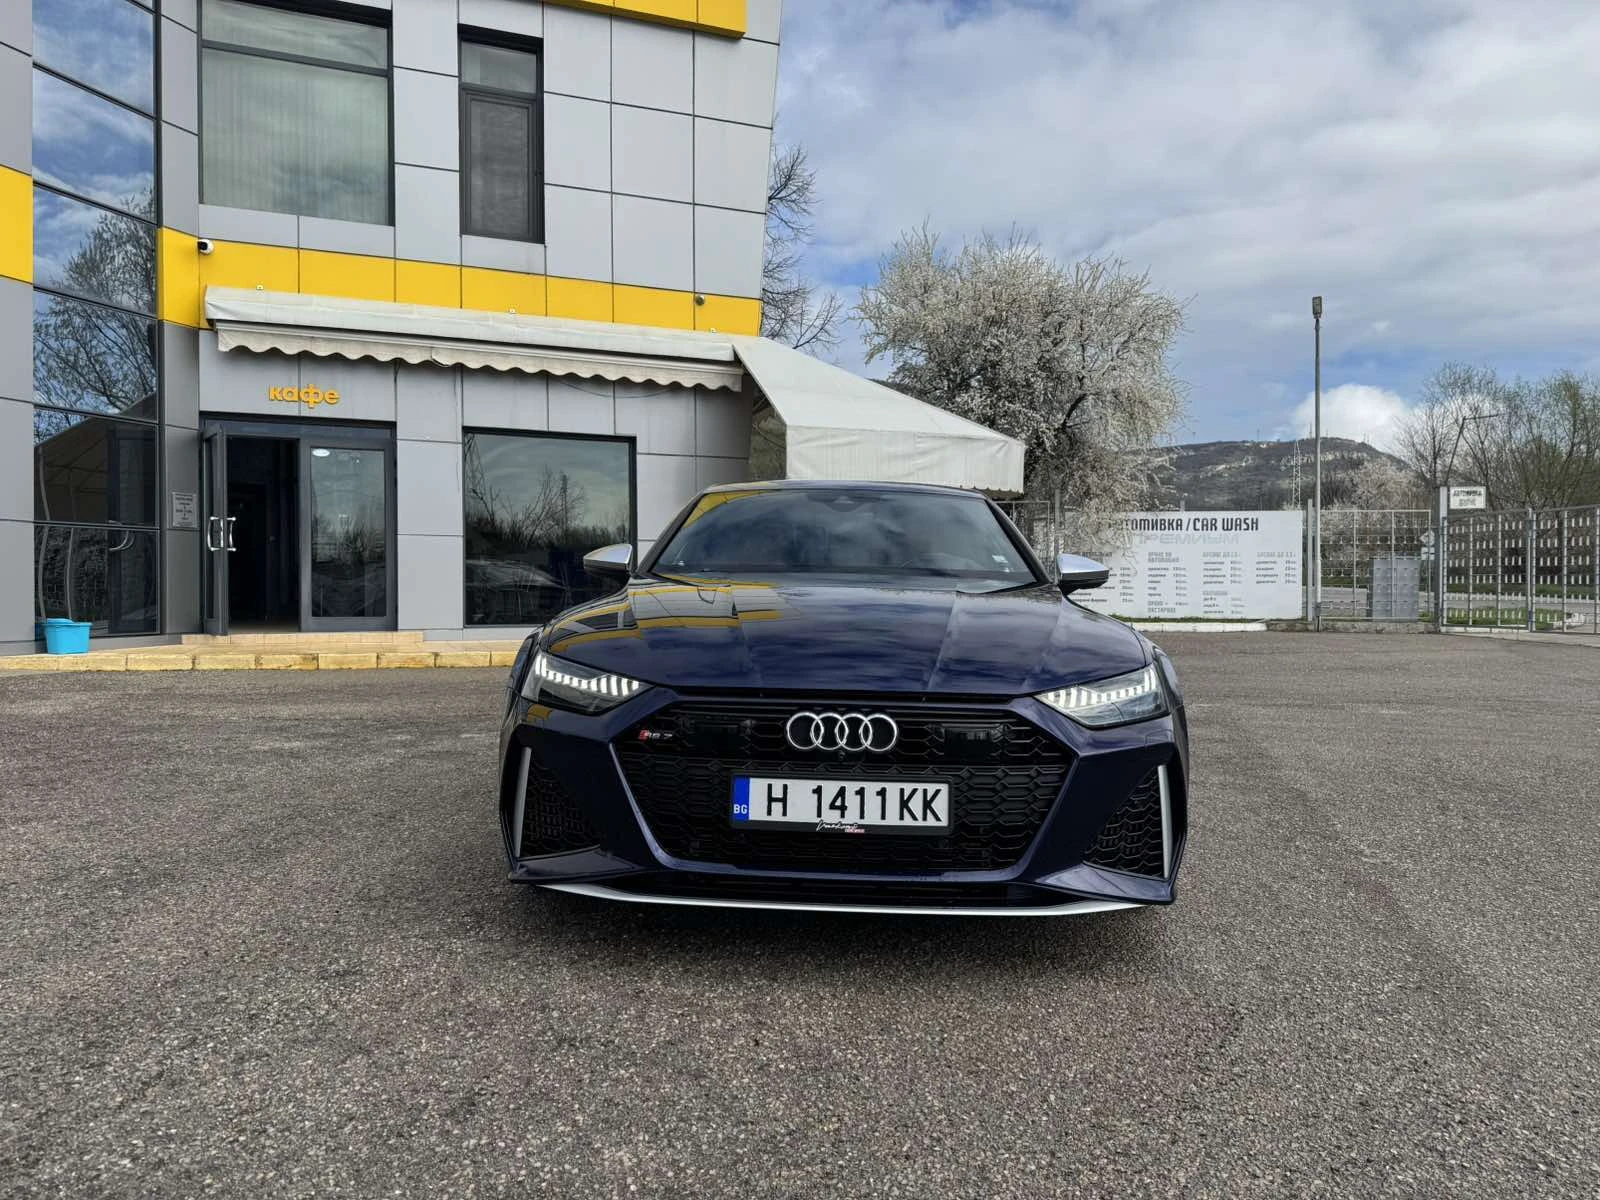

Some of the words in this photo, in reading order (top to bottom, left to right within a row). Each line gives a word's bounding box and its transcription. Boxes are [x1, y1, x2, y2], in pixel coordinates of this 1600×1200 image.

[269, 384, 339, 409] кафе
[1221, 517, 1259, 531] WASH
[733, 804, 748, 815] BG
[766, 783, 788, 817] H
